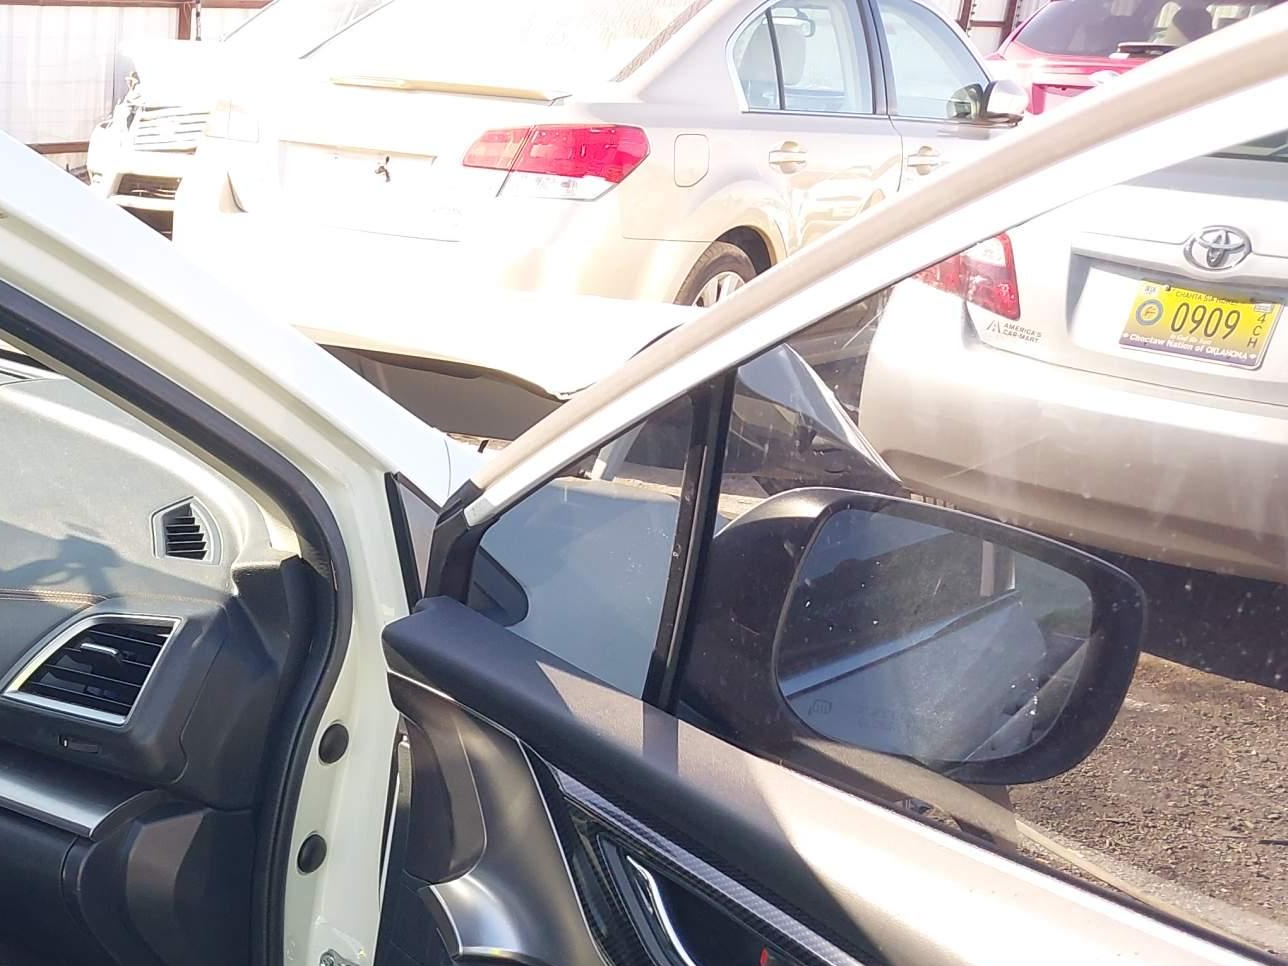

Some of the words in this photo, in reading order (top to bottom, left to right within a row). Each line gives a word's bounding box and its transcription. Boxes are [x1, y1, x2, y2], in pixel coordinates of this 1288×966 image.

[1171, 302, 1241, 340] 0909
[1166, 341, 1193, 351] Nation
[1195, 343, 1203, 351] of
[1206, 346, 1247, 360] OKLAHOMA
